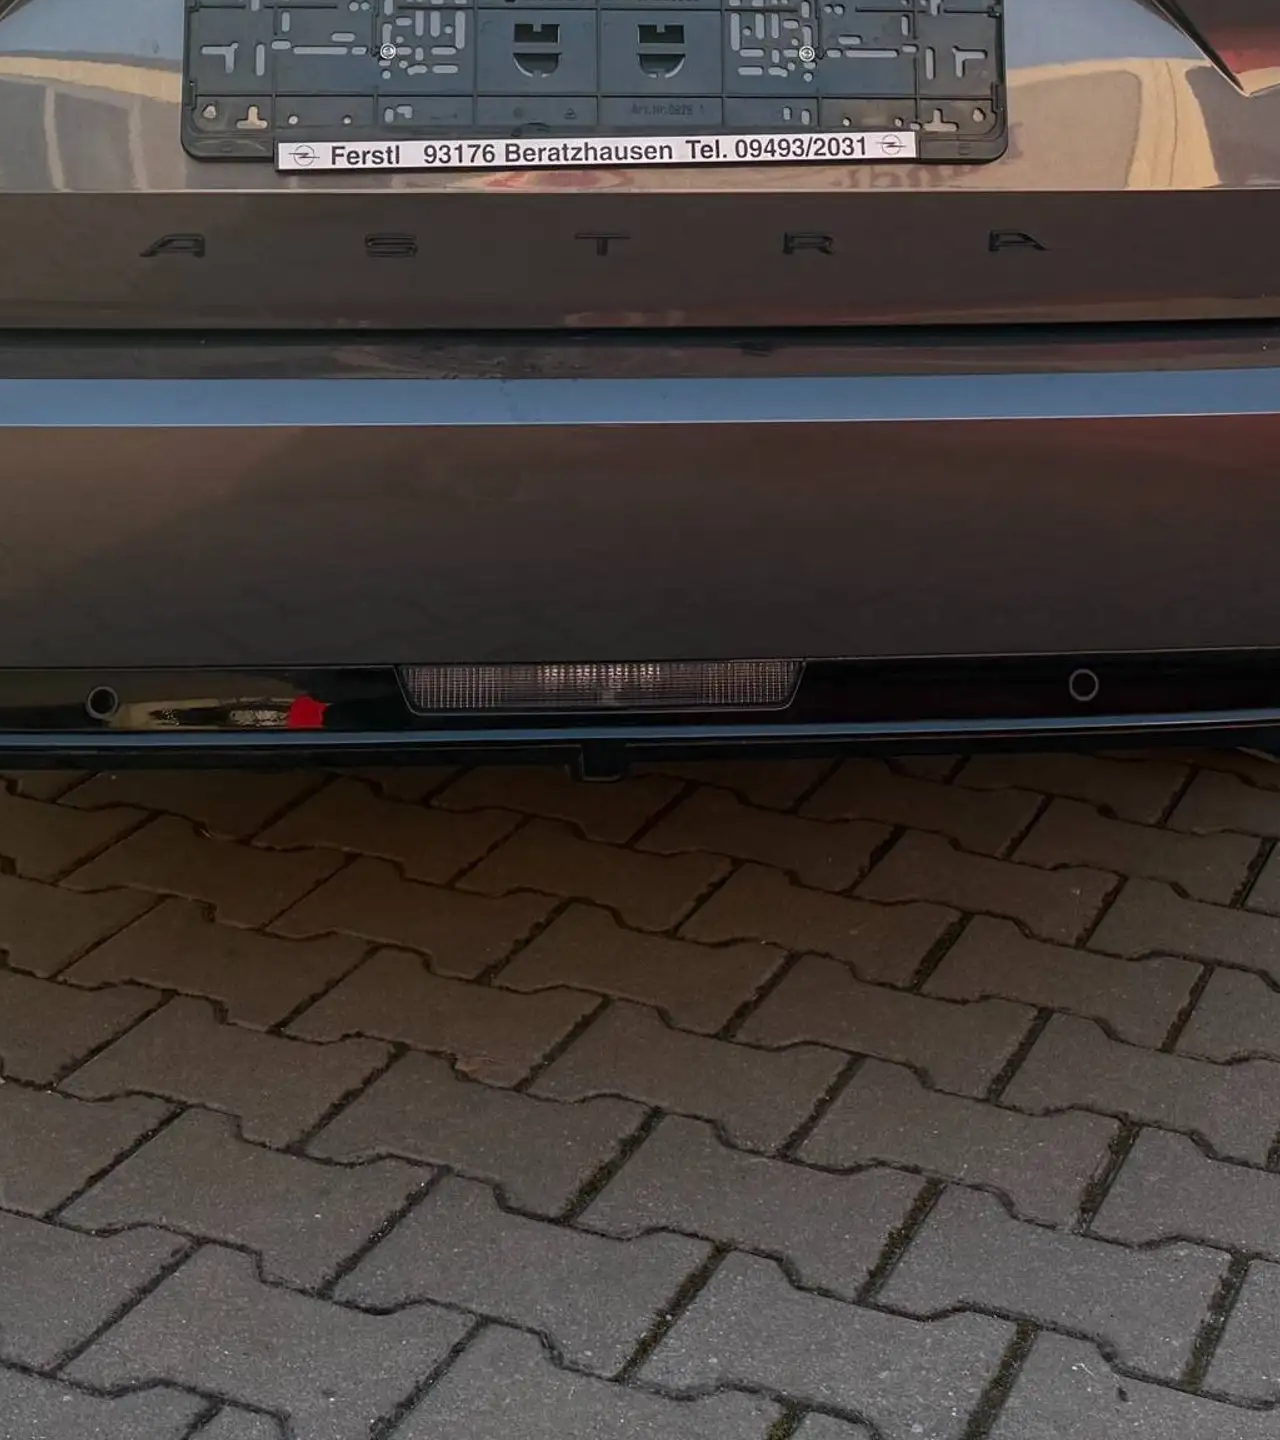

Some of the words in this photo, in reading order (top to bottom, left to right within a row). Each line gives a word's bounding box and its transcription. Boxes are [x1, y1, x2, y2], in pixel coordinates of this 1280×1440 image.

[331, 145, 400, 165] Ferstl
[423, 143, 496, 164] 93176
[504, 141, 673, 163] Beratzhausen
[685, 139, 727, 160] Tel.
[735, 136, 866, 159] 09493/2031
